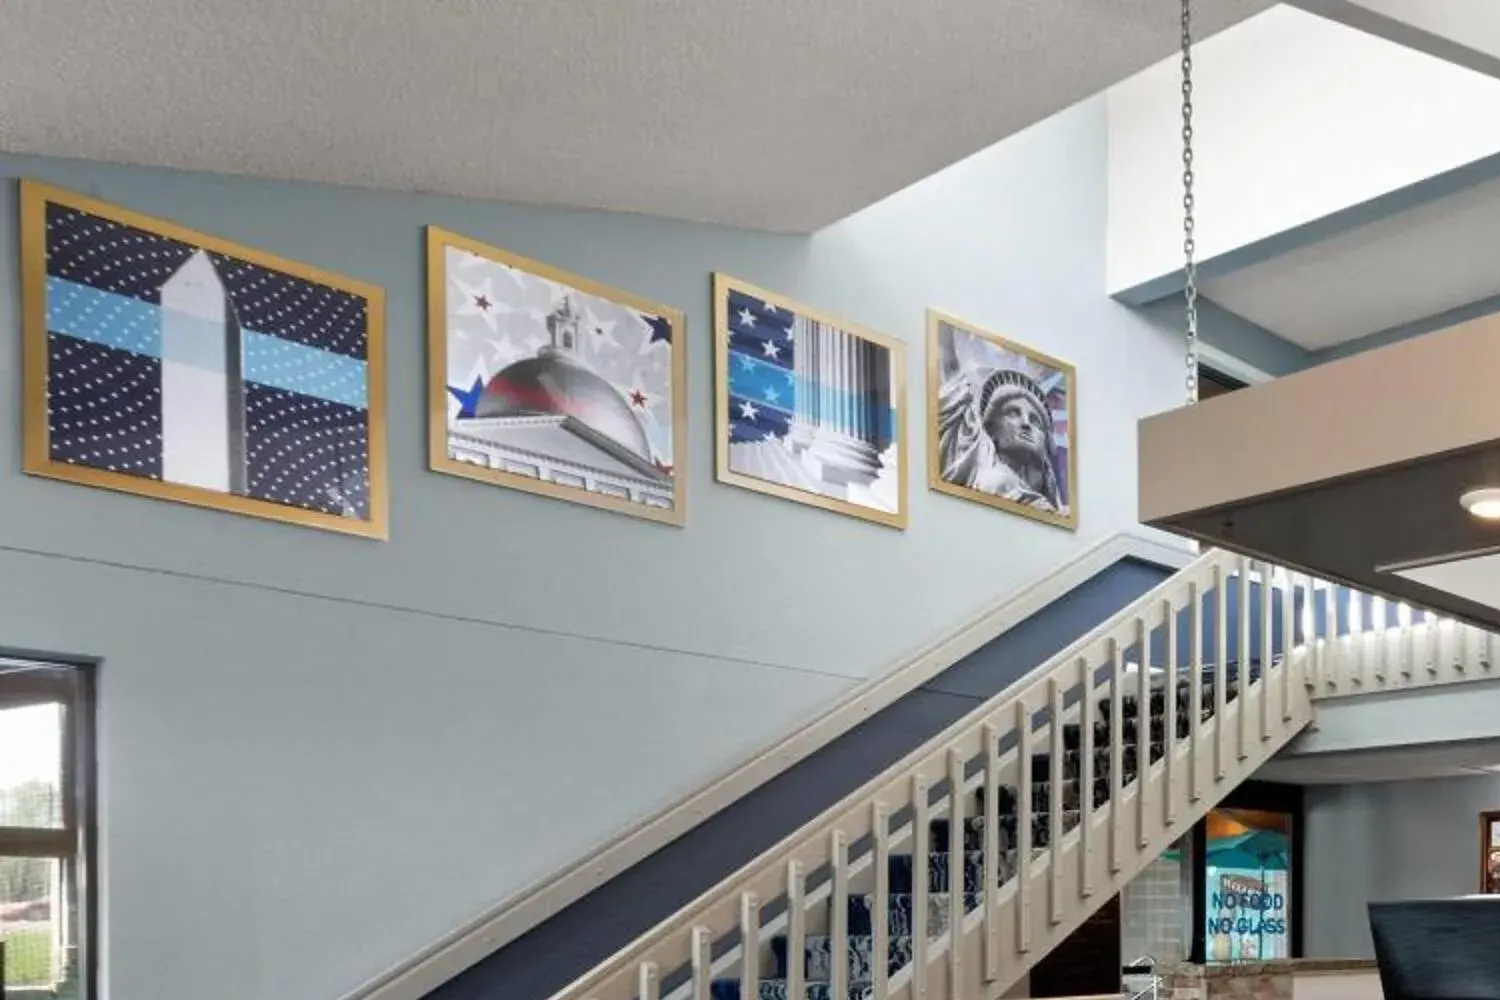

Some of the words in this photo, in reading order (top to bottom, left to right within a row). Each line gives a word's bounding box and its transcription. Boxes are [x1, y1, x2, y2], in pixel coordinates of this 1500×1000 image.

[1212, 892, 1237, 910] NO
[1239, 893, 1284, 911] FOOD
[1208, 917, 1233, 935] NO
[1236, 917, 1285, 935] GLASS
